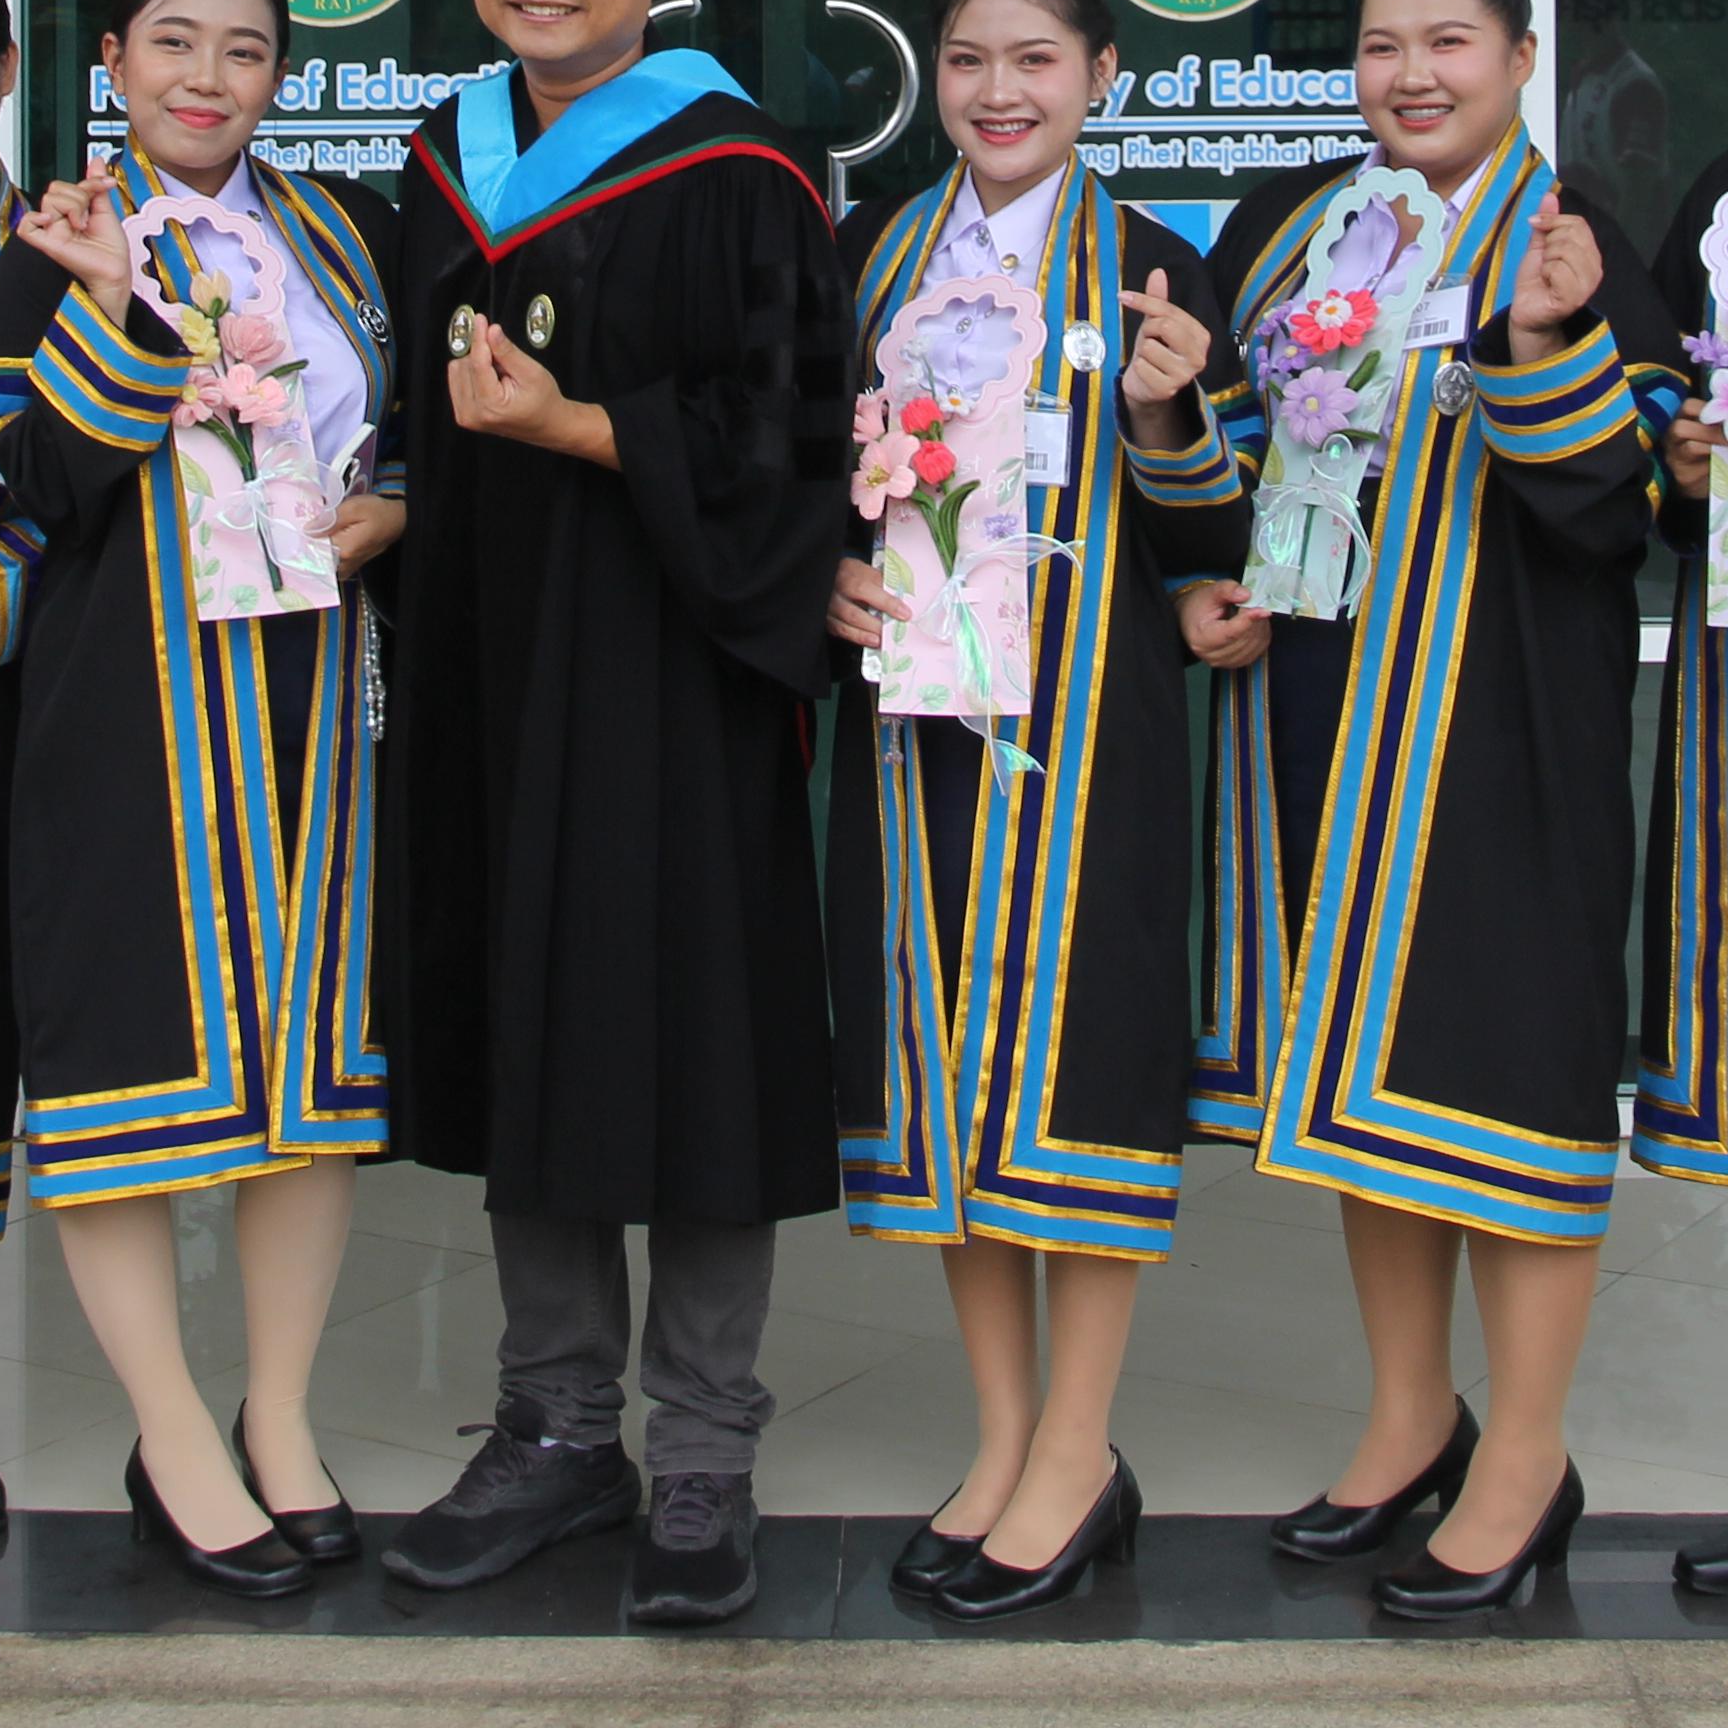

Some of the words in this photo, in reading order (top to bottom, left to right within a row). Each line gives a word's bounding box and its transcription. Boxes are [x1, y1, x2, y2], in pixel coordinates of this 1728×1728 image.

[273, 58, 327, 110] of
[1145, 54, 1201, 108] of
[1210, 54, 1357, 106] Educa
[250, 138, 312, 171] Phet
[313, 139, 411, 179] Rajabh
[1122, 134, 1185, 168] Phet
[1187, 133, 1311, 176] Rajabhat
